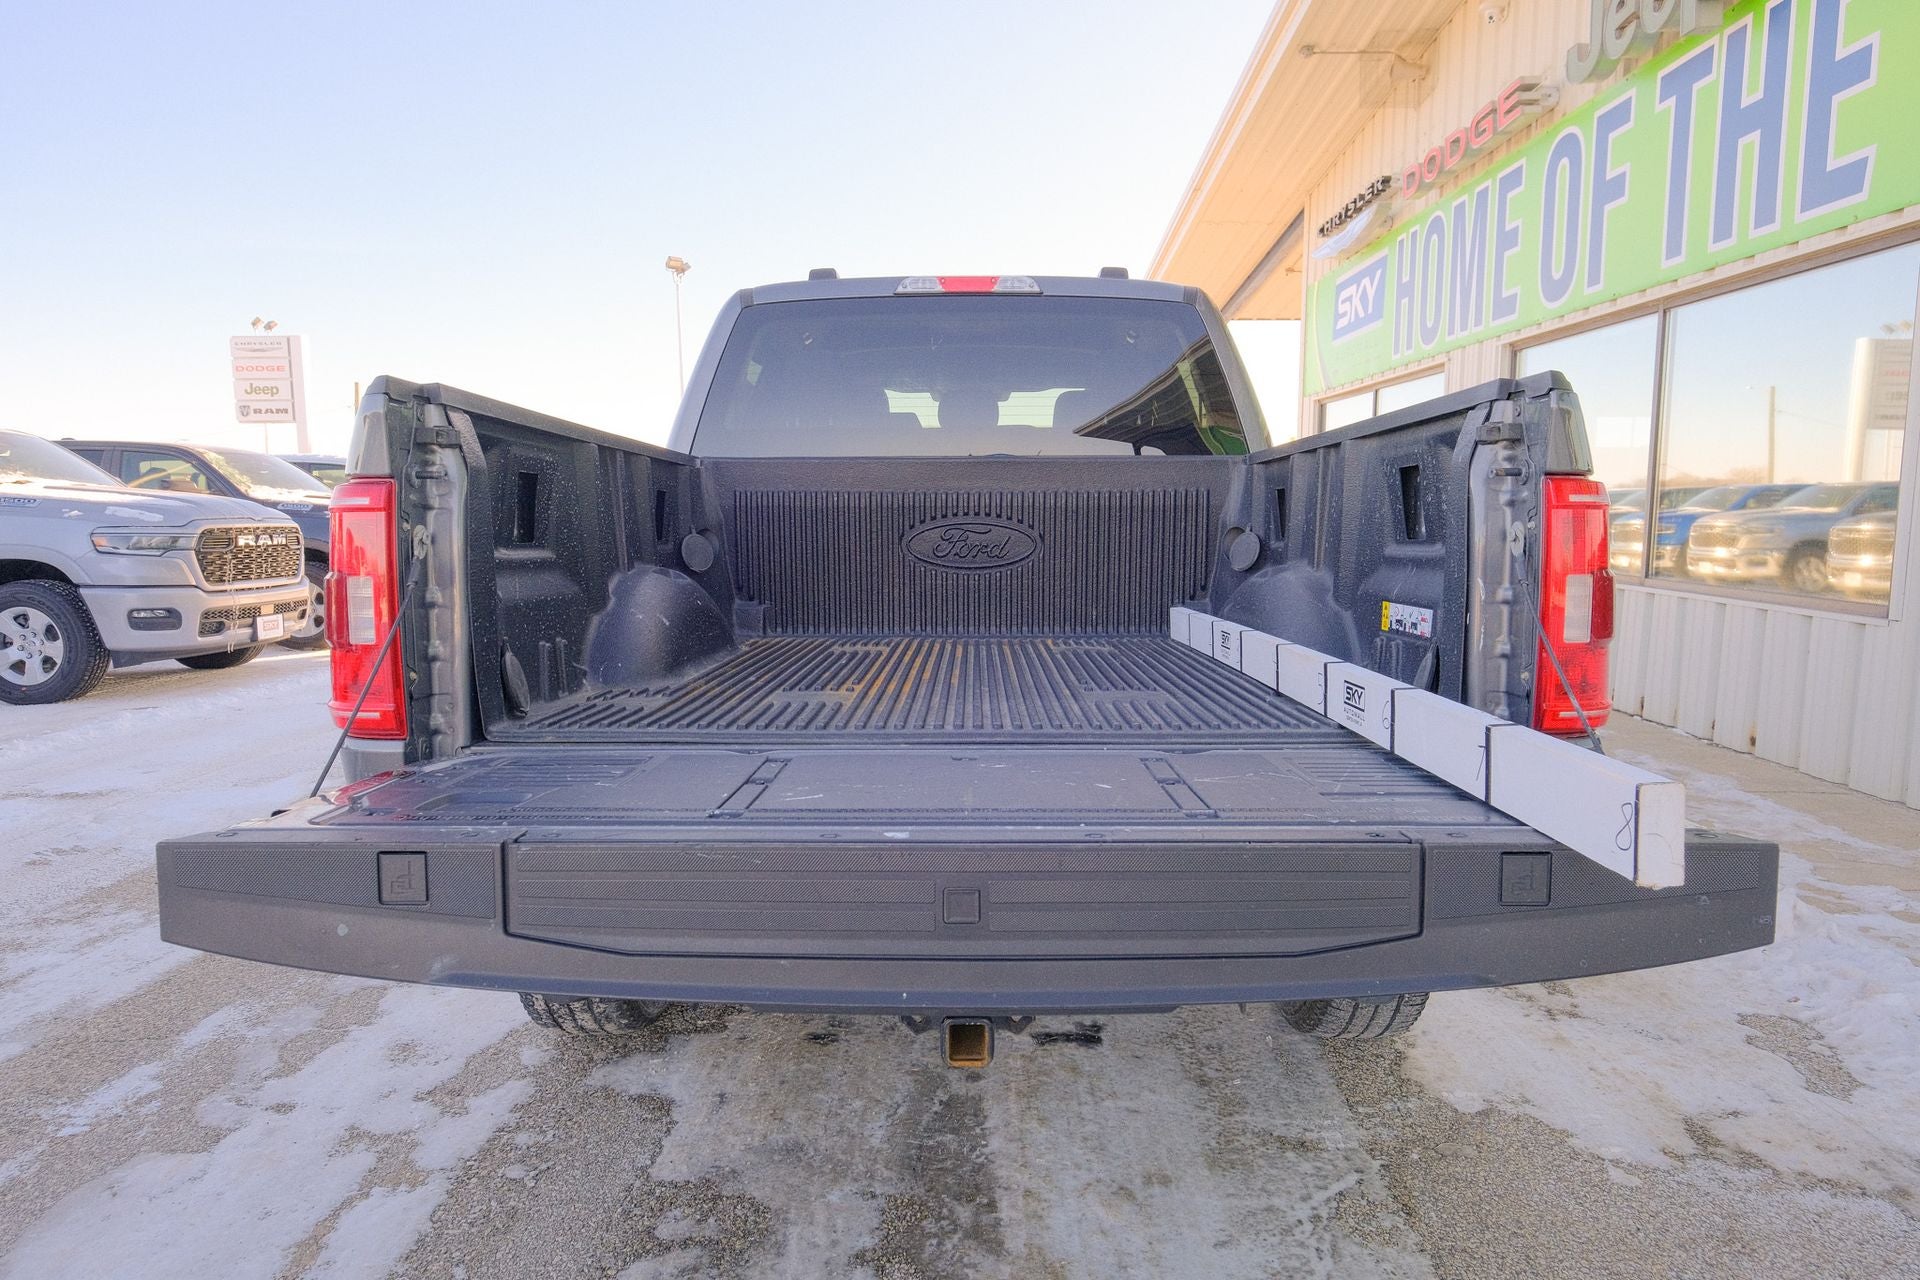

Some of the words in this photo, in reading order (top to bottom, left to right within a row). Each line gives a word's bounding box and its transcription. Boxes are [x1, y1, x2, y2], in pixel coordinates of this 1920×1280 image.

[1402, 80, 1522, 199] DODGE
[1392, 156, 1527, 359] HOME
[1538, 87, 1637, 309] OF
[1655, 0, 1881, 269] THE
[1317, 176, 1391, 237] CHRYSLER
[1335, 268, 1382, 330] SKY
[236, 365, 287, 373] DODGE
[244, 382, 280, 398] Jeep
[253, 407, 289, 415] RAM
[237, 533, 288, 547] RAM
[933, 527, 1012, 559] Ford
[1345, 685, 1363, 706] SKY
[1382, 699, 1391, 730] 6
[1475, 744, 1486, 782] 7
[1615, 802, 1634, 851] 8
